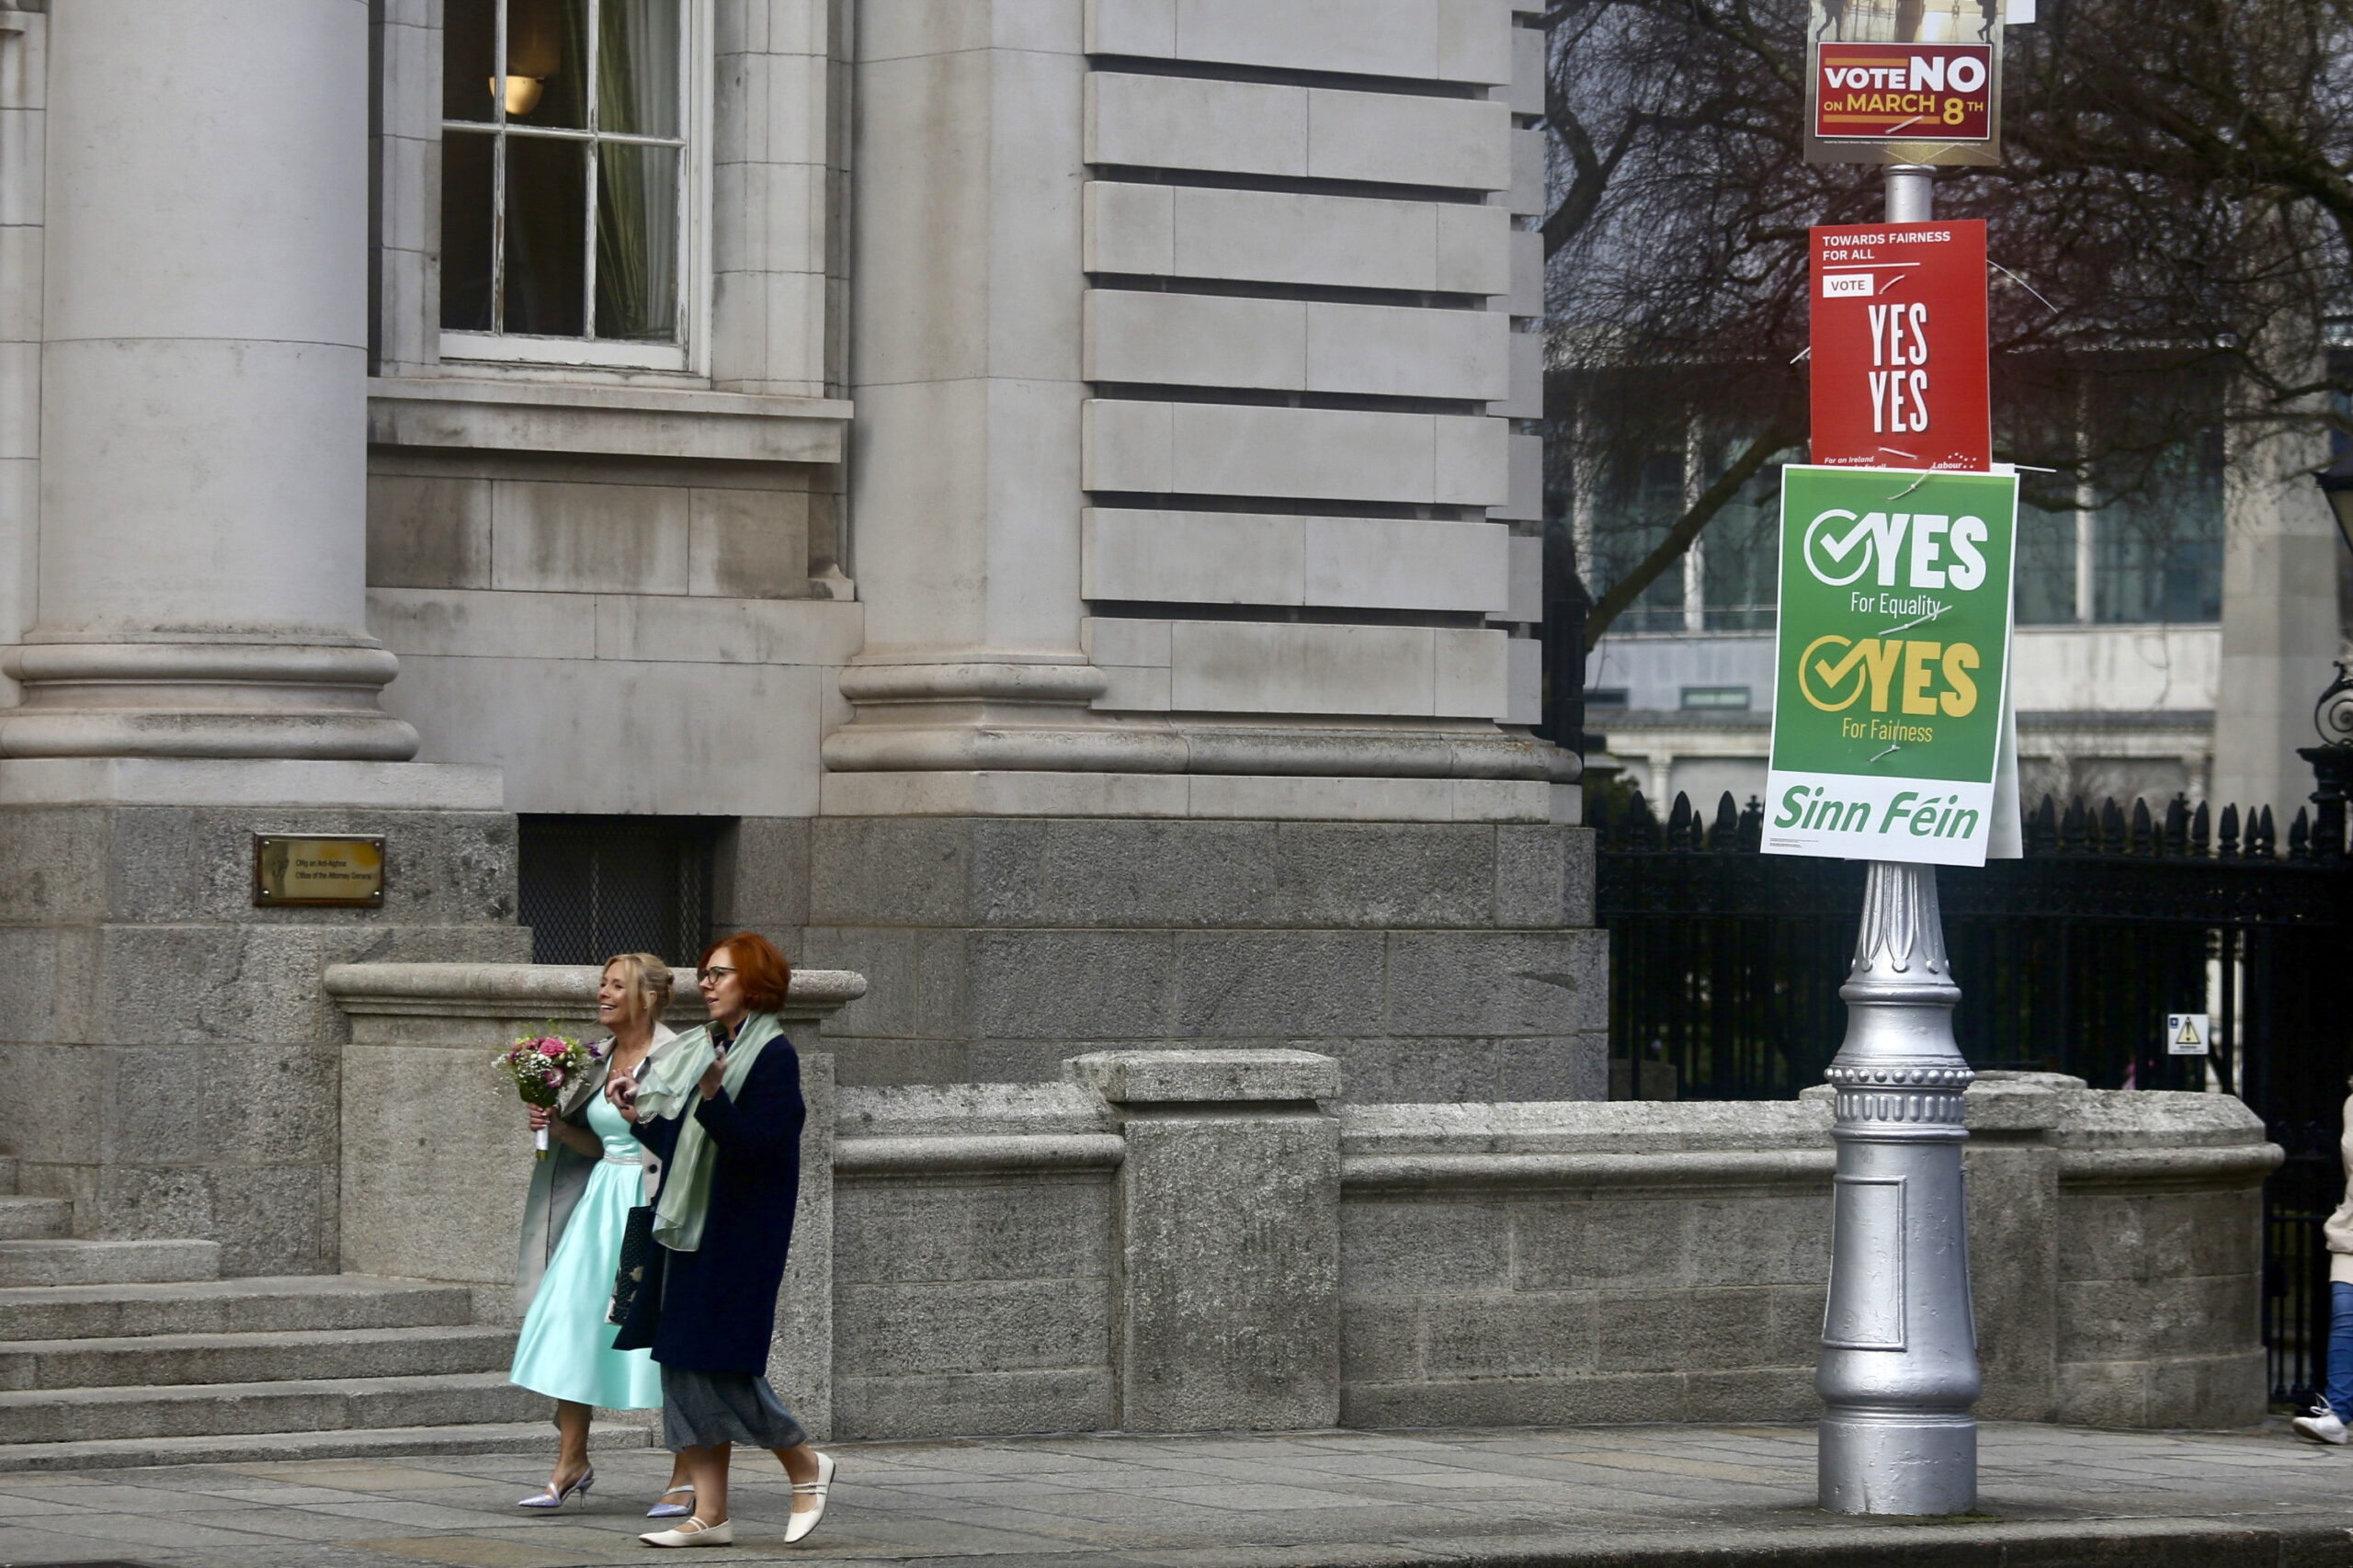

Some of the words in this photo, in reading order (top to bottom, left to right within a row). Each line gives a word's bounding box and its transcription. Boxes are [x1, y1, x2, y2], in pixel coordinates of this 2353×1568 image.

[1824, 67, 1907, 90] VOTE
[1909, 56, 1986, 93] NO
[1824, 101, 1843, 112] ON
[1847, 94, 1936, 113] MARCH
[1823, 233, 1885, 246] TOWARDS
[1889, 231, 1950, 244] FAIRNESS
[1823, 250, 1847, 261] FOR
[1851, 249, 1875, 260] ALL
[1831, 279, 1866, 291] VOTE
[1868, 302, 1927, 366] YES
[1869, 369, 1928, 433] YES
[1932, 461, 1962, 470] Labour
[1869, 512, 1988, 591] YES
[1850, 592, 1875, 613] For
[1880, 593, 1941, 620] Equality
[1862, 638, 1981, 718] YES
[1842, 718, 1867, 738] For
[1870, 719, 1933, 743] Fairness
[1773, 785, 1871, 833] Sinn
[1878, 791, 1979, 839] Féin
